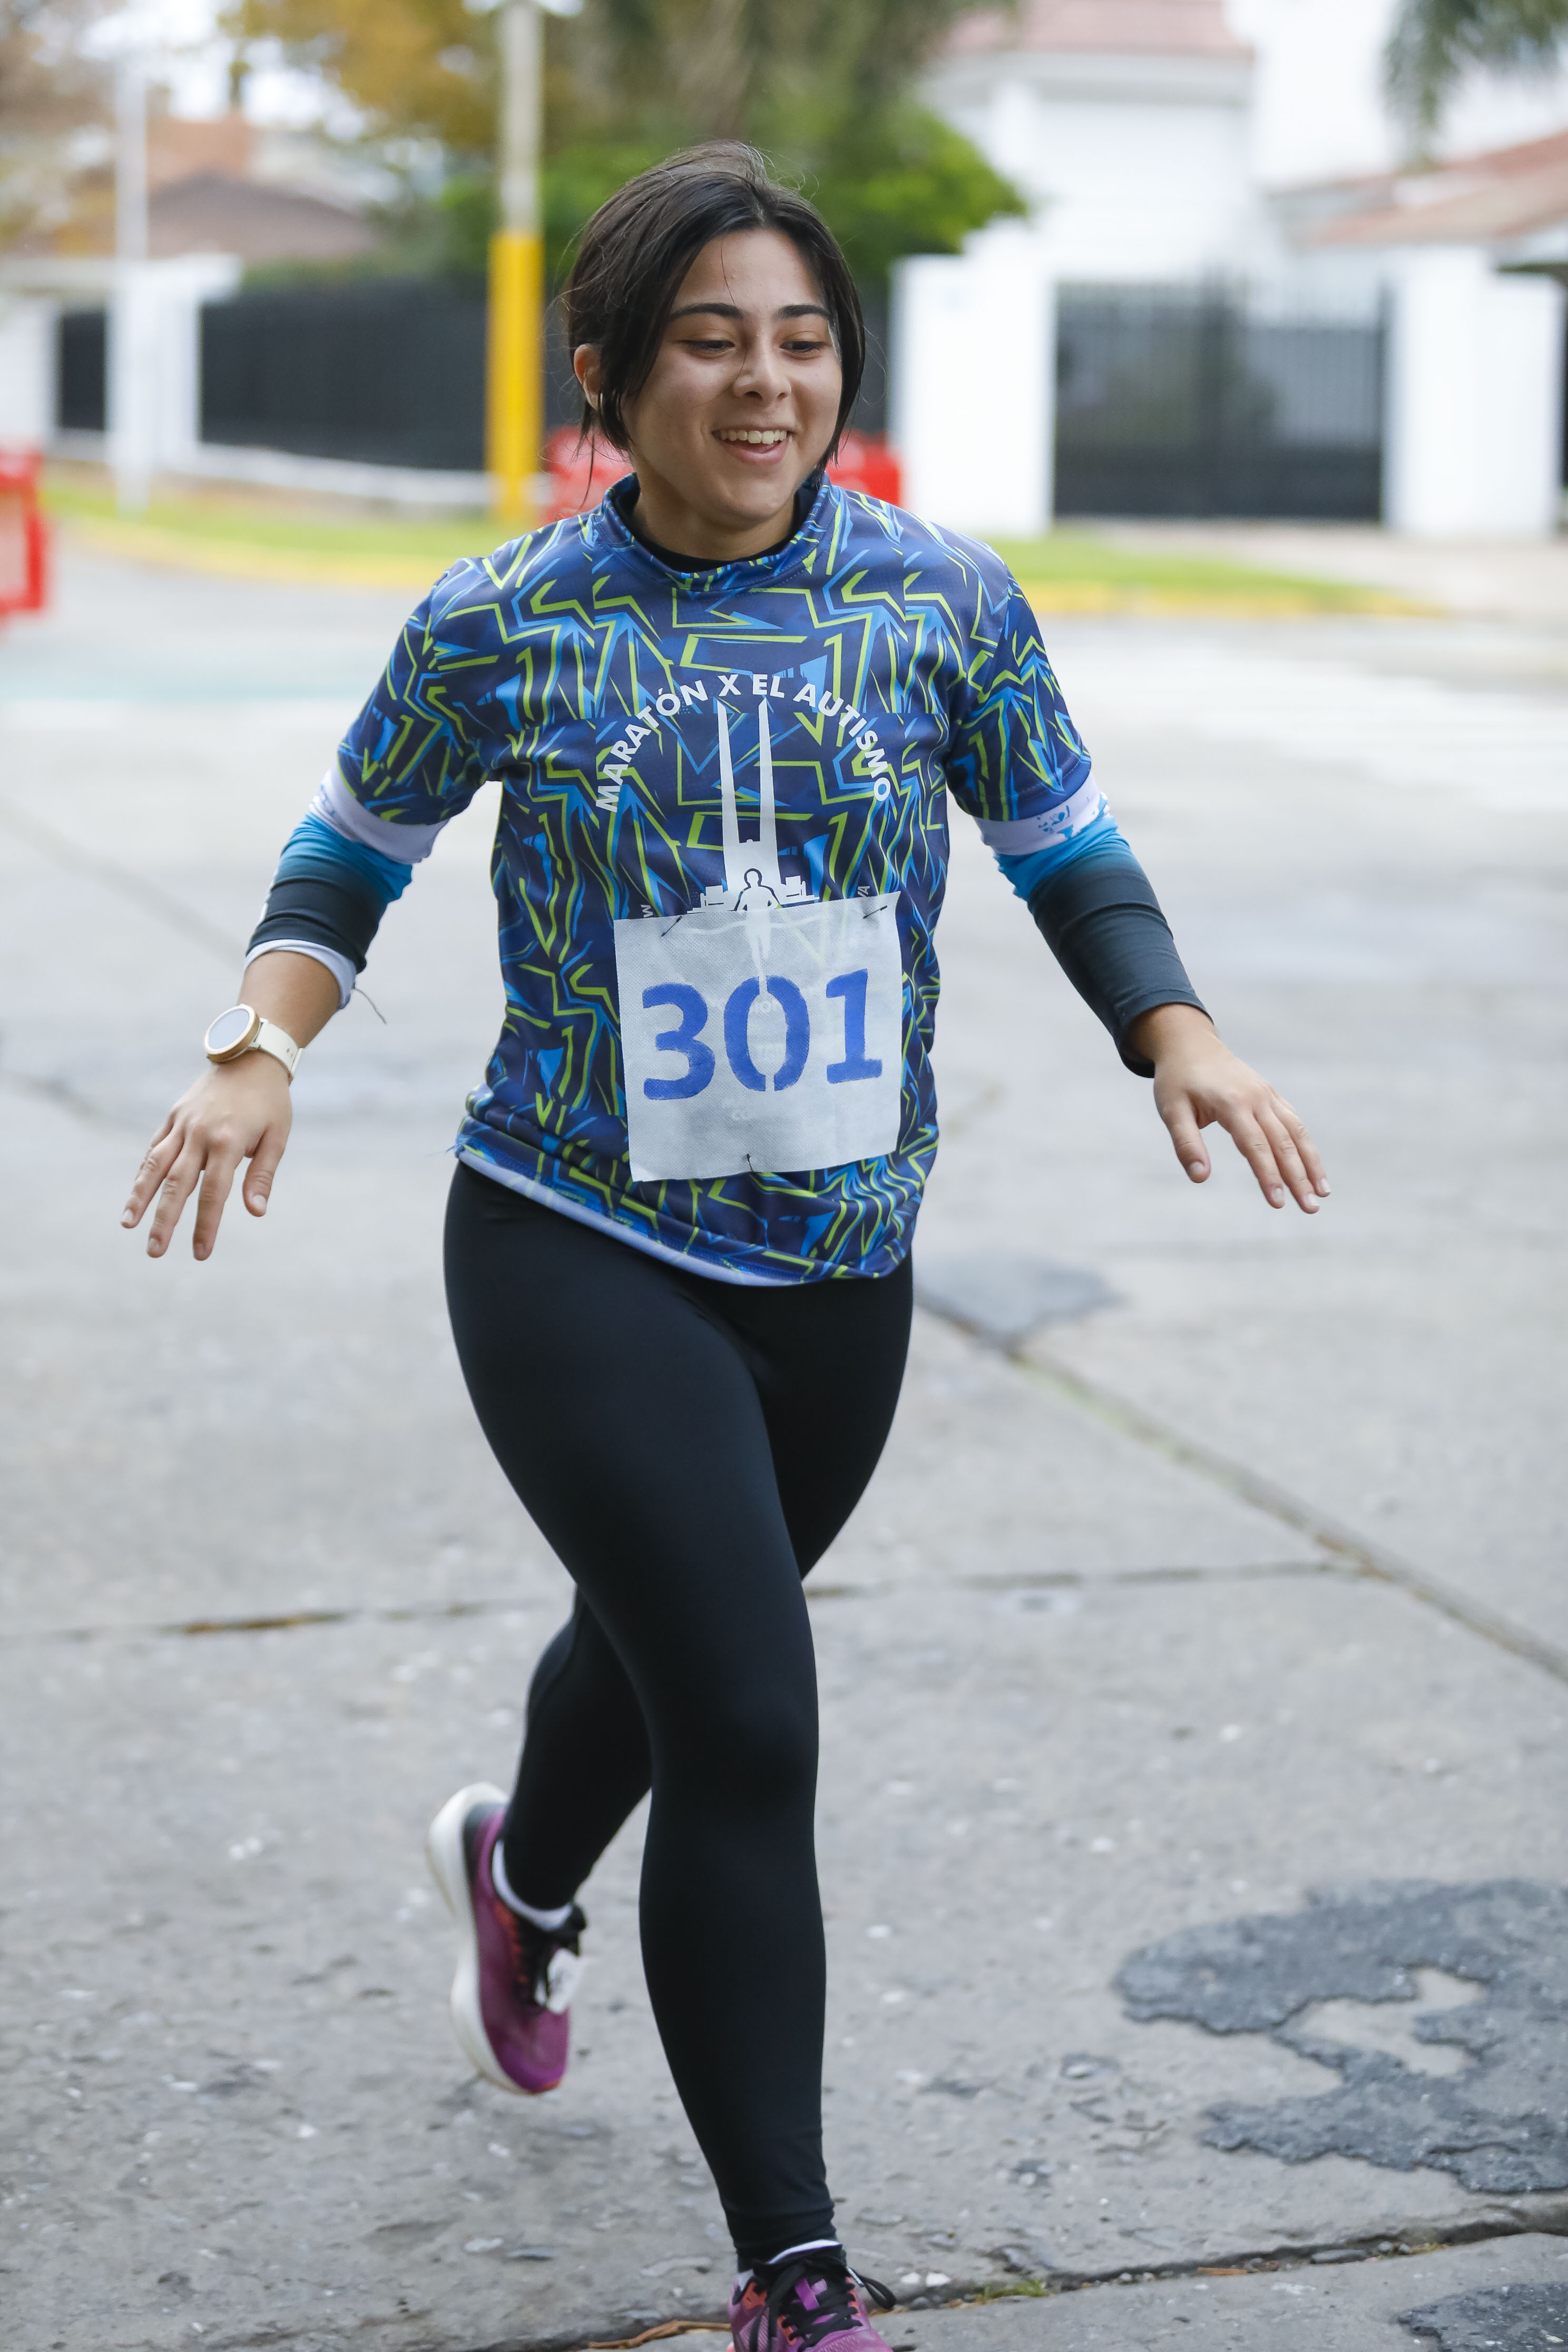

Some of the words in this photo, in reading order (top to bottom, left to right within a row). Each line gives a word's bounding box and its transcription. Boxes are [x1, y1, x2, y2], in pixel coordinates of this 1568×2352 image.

[595, 680, 709, 812] MARATÓN
[717, 673, 741, 697] X
[752, 674, 785, 699] EL
[792, 683, 891, 801] AUTISMO
[642, 968, 883, 1100] 301
